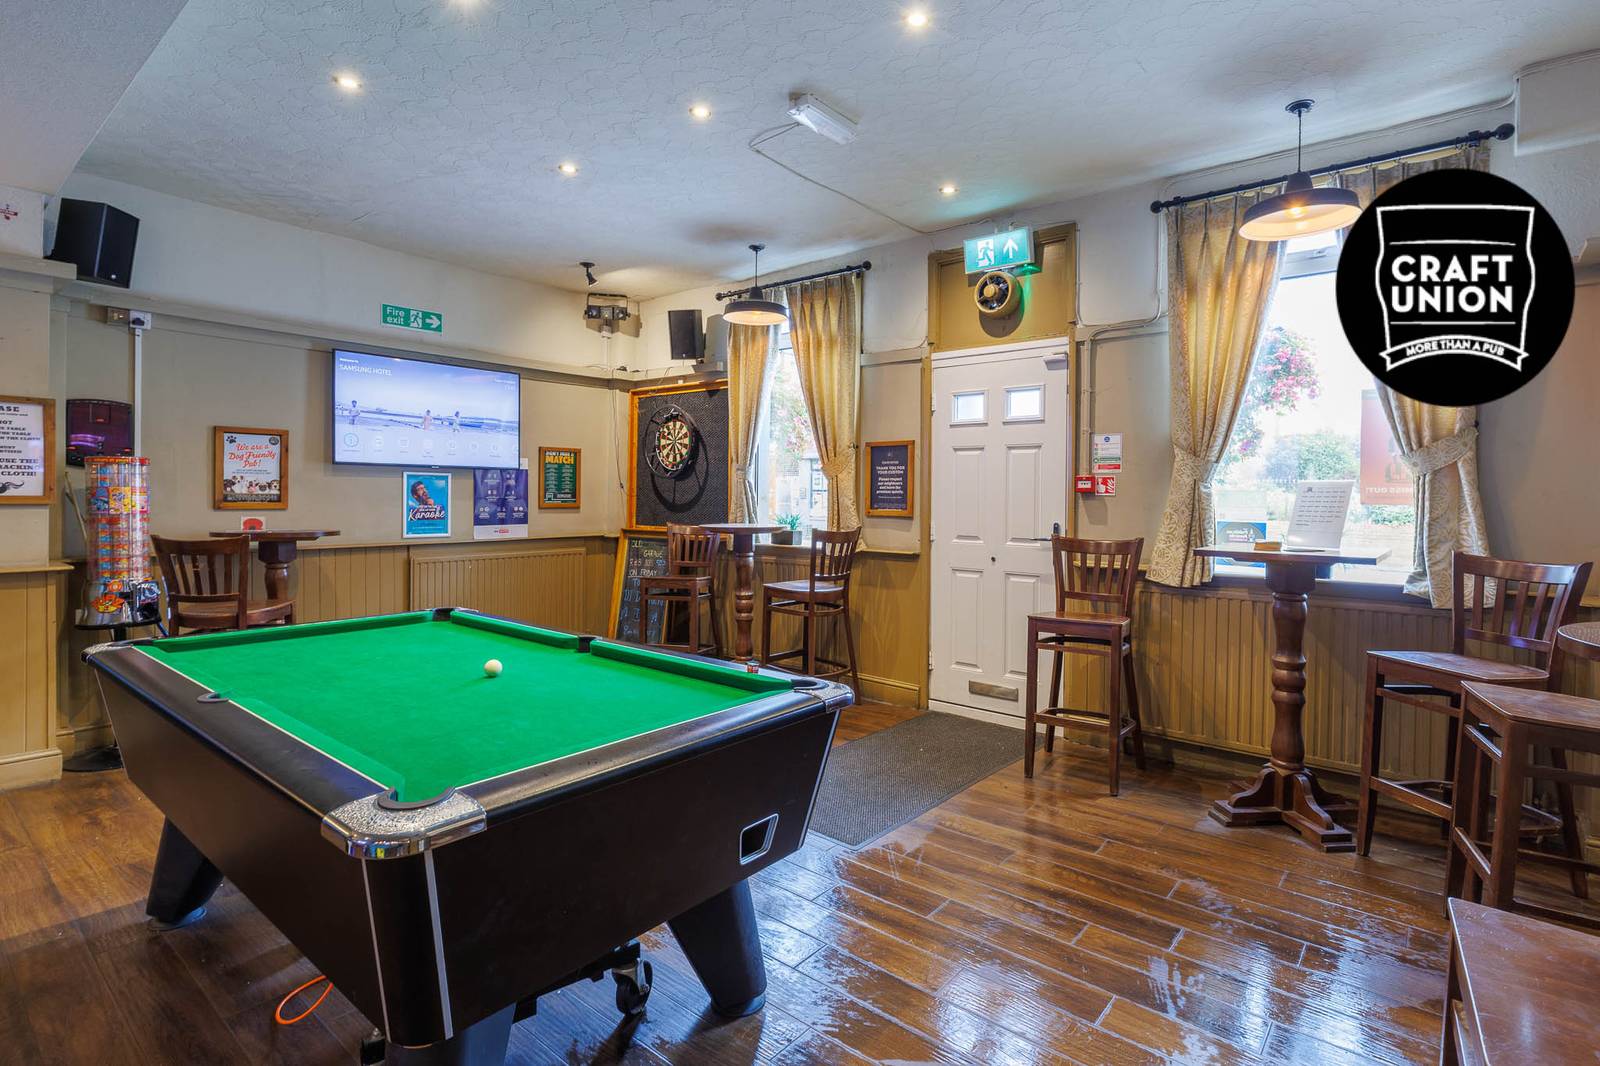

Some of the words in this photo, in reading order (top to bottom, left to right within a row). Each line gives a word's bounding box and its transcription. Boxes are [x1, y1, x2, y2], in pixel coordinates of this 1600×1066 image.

[386, 306, 405, 317] Fire
[386, 316, 404, 325] exit
[228, 452, 246, 461] Dog
[546, 456, 574, 464] MATCH
[408, 505, 446, 521] Karaoke
